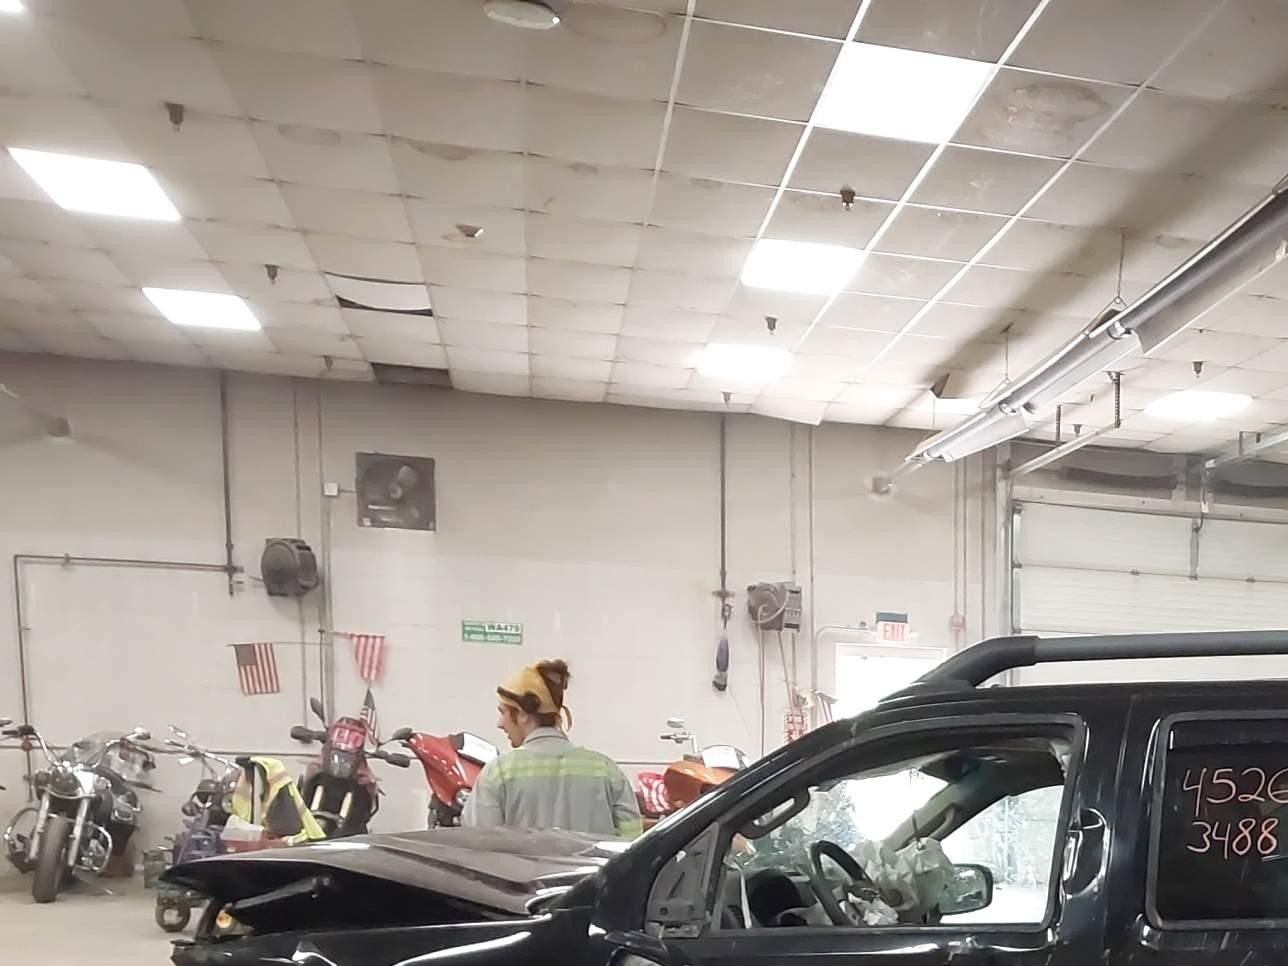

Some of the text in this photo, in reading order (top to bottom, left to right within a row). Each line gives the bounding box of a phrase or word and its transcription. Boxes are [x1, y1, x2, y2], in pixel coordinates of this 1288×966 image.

[487, 623, 520, 633] WA479
[883, 624, 906, 641] EXIT
[1186, 817, 1279, 860] 3488
